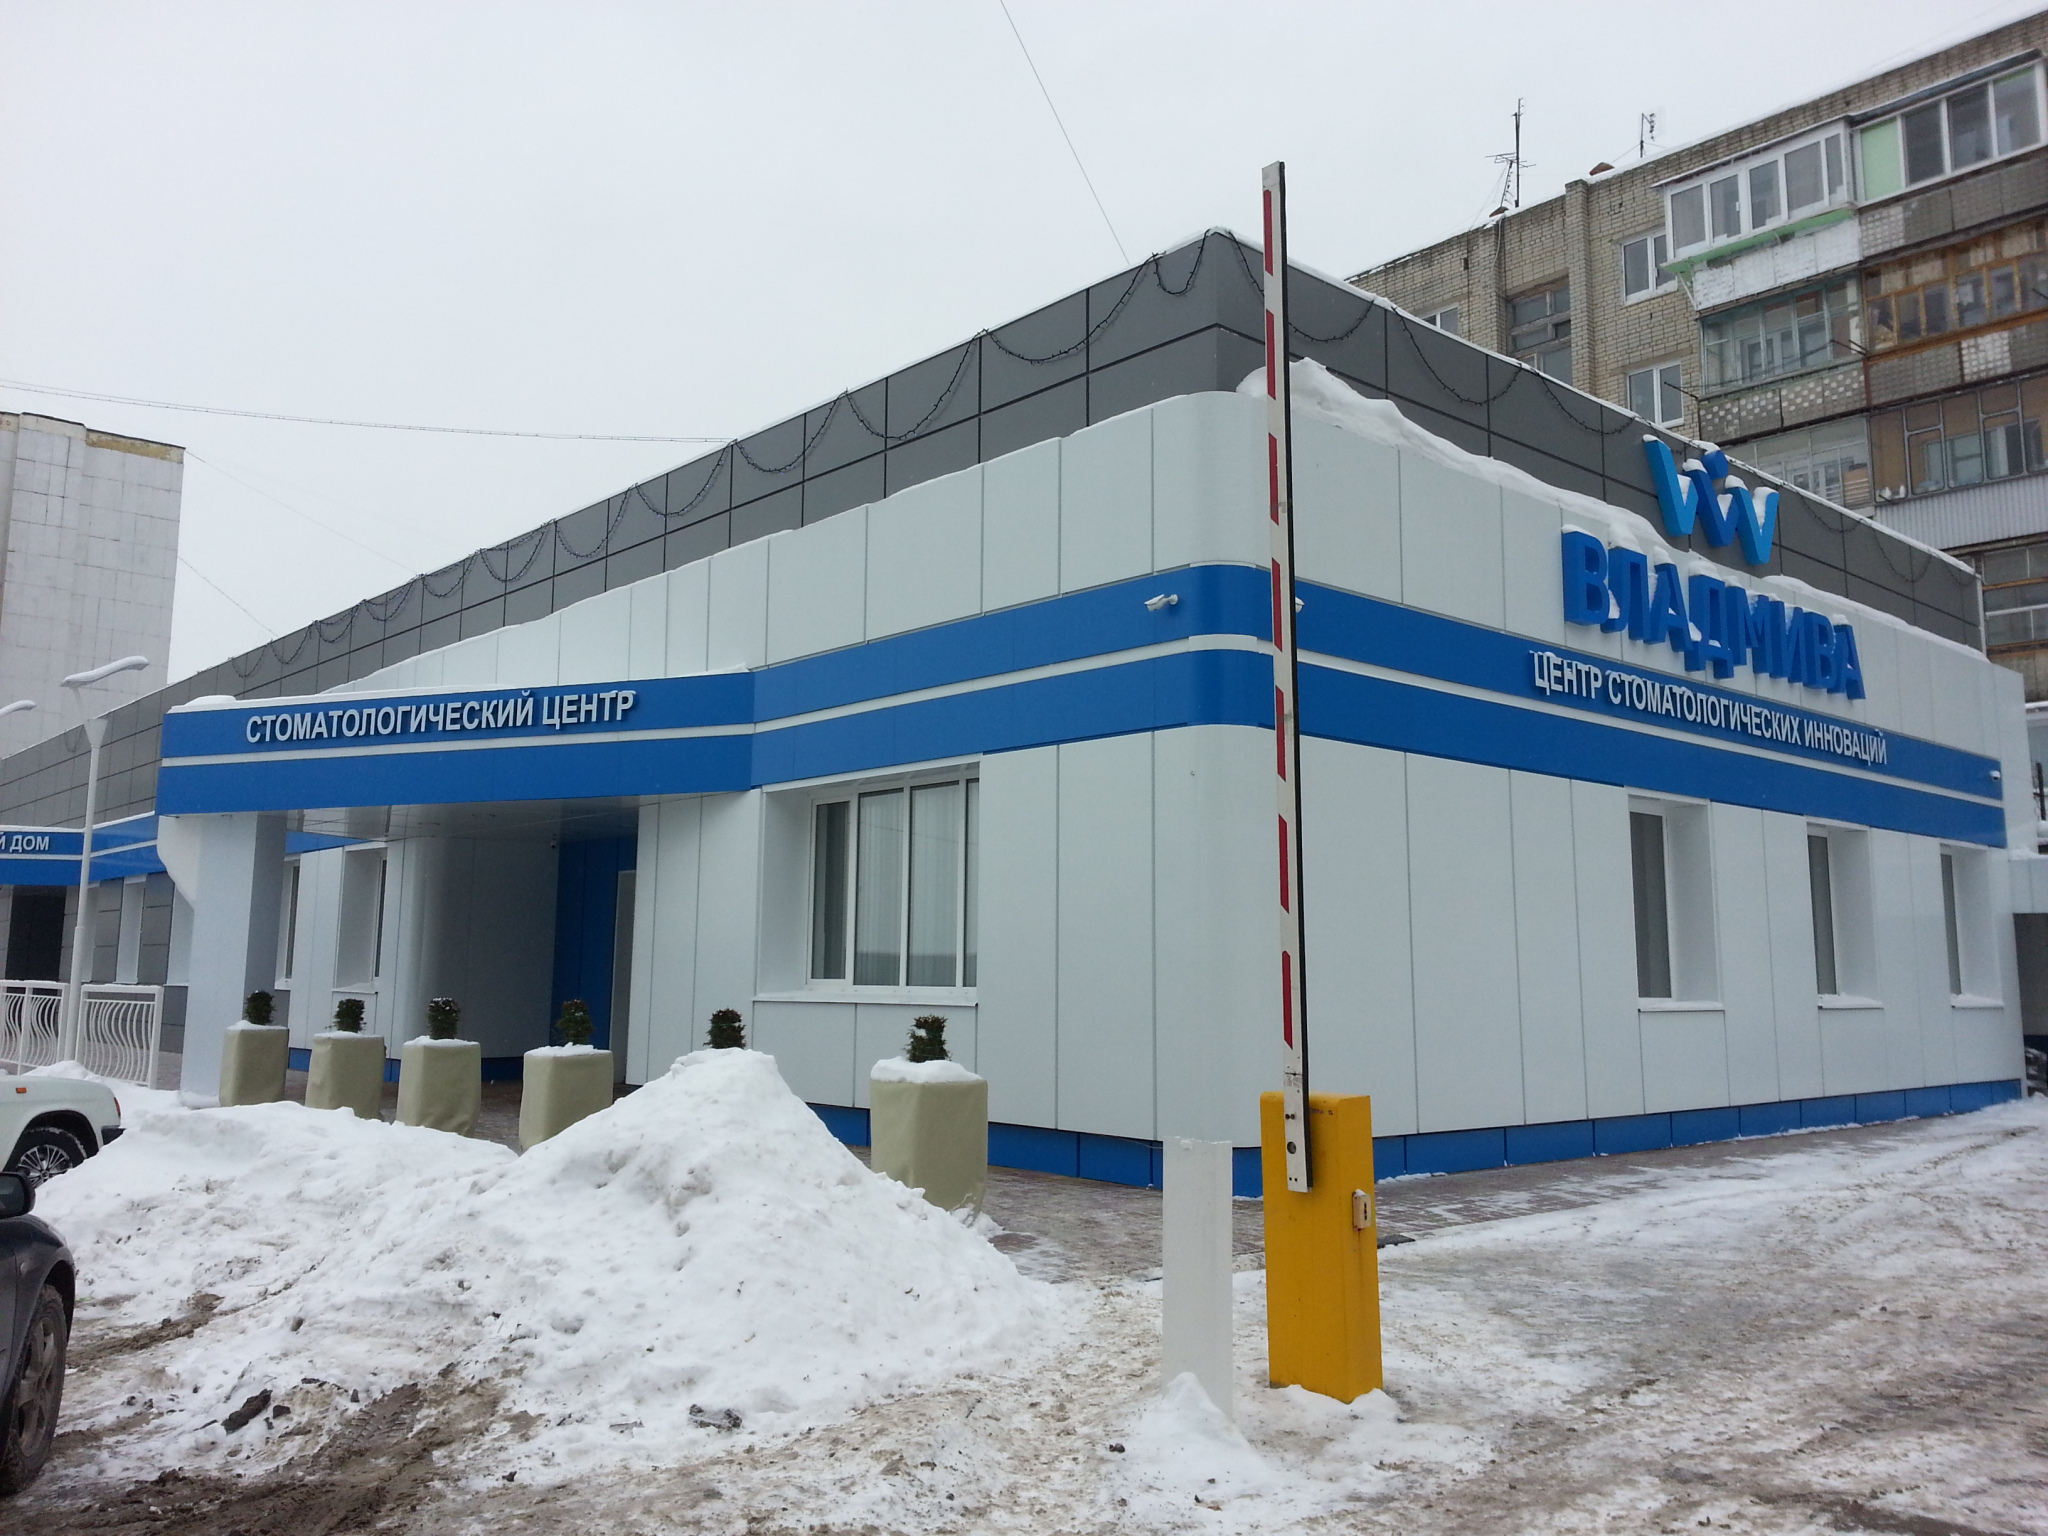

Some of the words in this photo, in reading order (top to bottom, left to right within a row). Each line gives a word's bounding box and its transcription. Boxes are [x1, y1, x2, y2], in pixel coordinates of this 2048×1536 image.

[1561, 528, 1866, 700] ВЛАДМИВА
[245, 689, 534, 743] СТОМАТОЛОГИЧЕСКИЙ
[541, 690, 635, 730] ЦЕНТР
[1533, 650, 1603, 699] ЦЕНТР
[1607, 670, 1801, 746] СТОМАТОЛОГИЧЕСКИХ
[1803, 718, 1888, 766] ИННОВАЦИЙ
[9, 834, 50, 853] ДОМ
